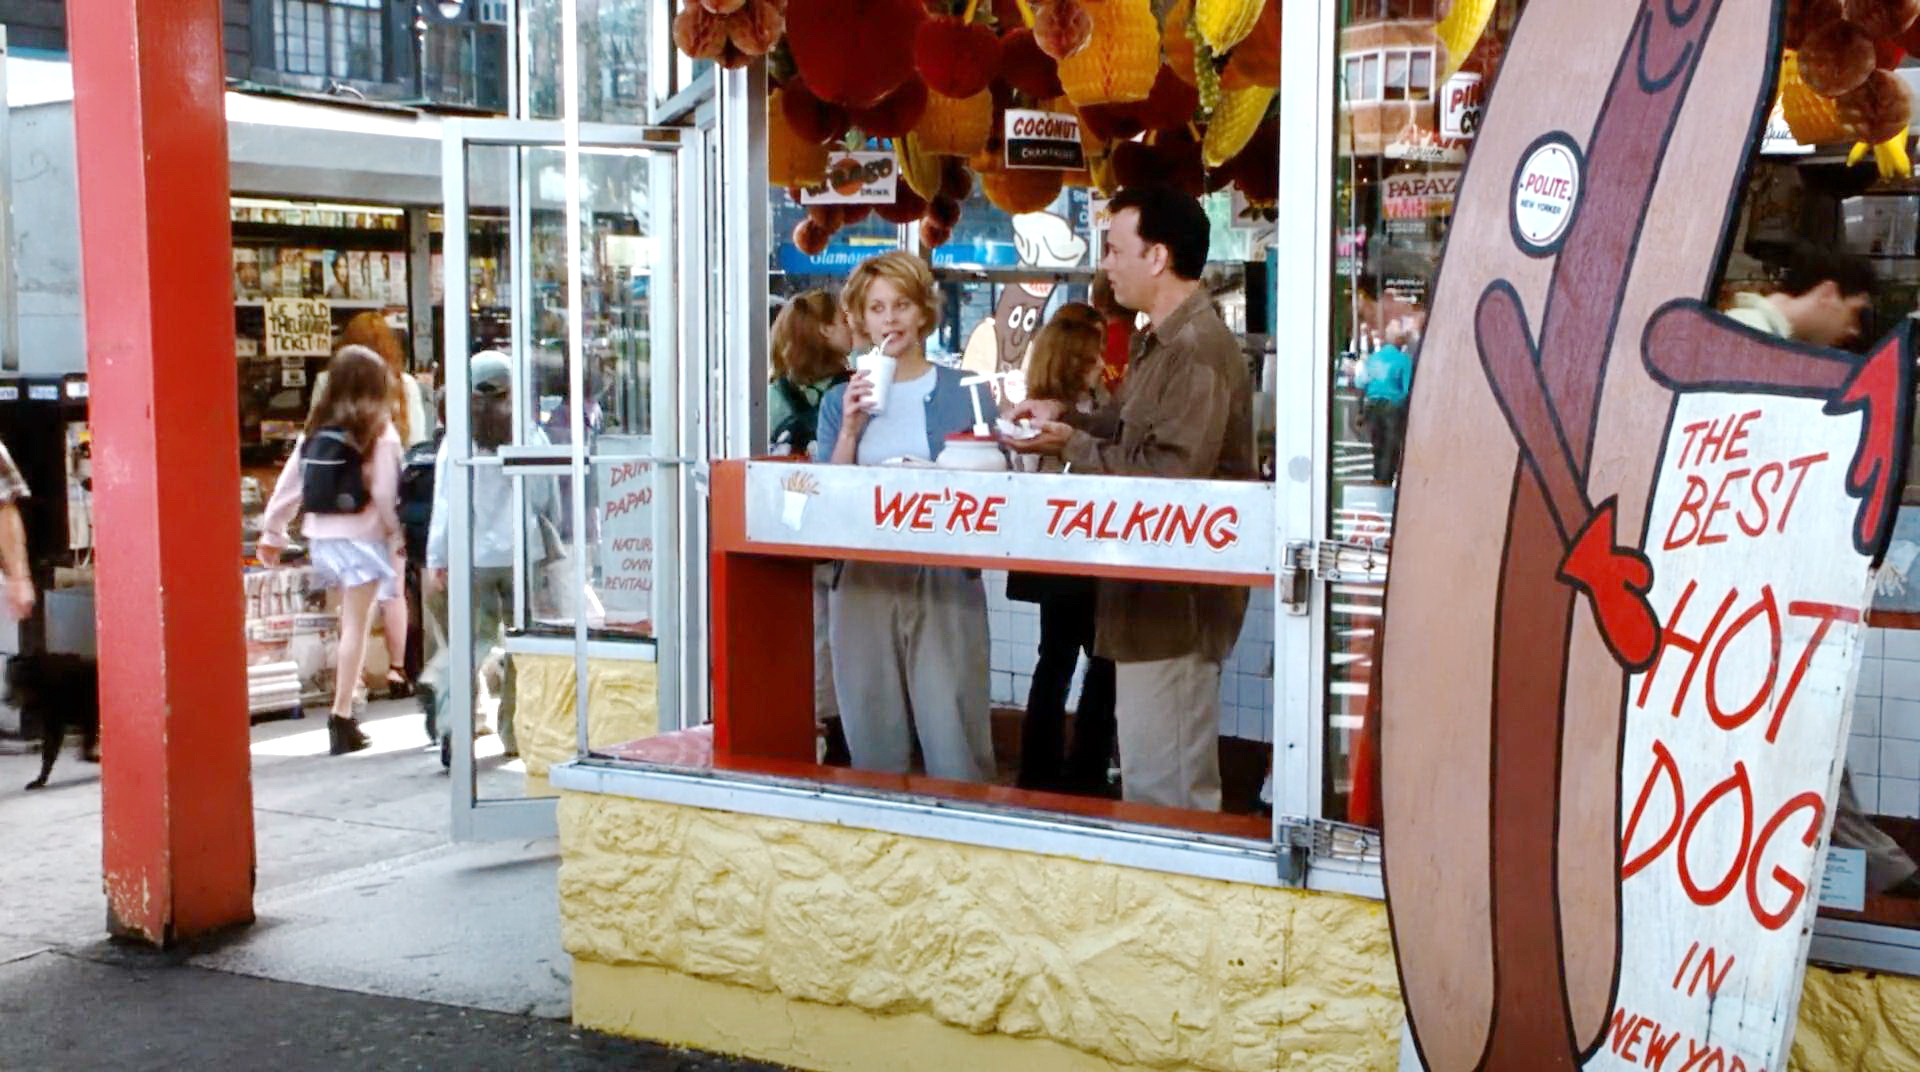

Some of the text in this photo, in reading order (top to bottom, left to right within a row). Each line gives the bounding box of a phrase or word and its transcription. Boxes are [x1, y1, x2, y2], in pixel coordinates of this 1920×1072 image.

[1013, 117, 1078, 138] COCONUT
[1387, 178, 1457, 198] PAPAY
[1525, 172, 1570, 199] POLITE
[1520, 199, 1562, 215] NEW YORKER
[809, 249, 863, 265] Glamou
[297, 302, 328, 319] SOLD
[271, 333, 313, 351] TICKET
[1677, 409, 1762, 469] THE
[1662, 452, 1829, 551] BEST
[873, 484, 1240, 550] WE'RE TALKING
[622, 558, 653, 572] OWN
[1636, 578, 1860, 744] HOT
[1620, 739, 1826, 931] DOG
[1672, 941, 1736, 998] IN
[1605, 1007, 1681, 1072] NEW
